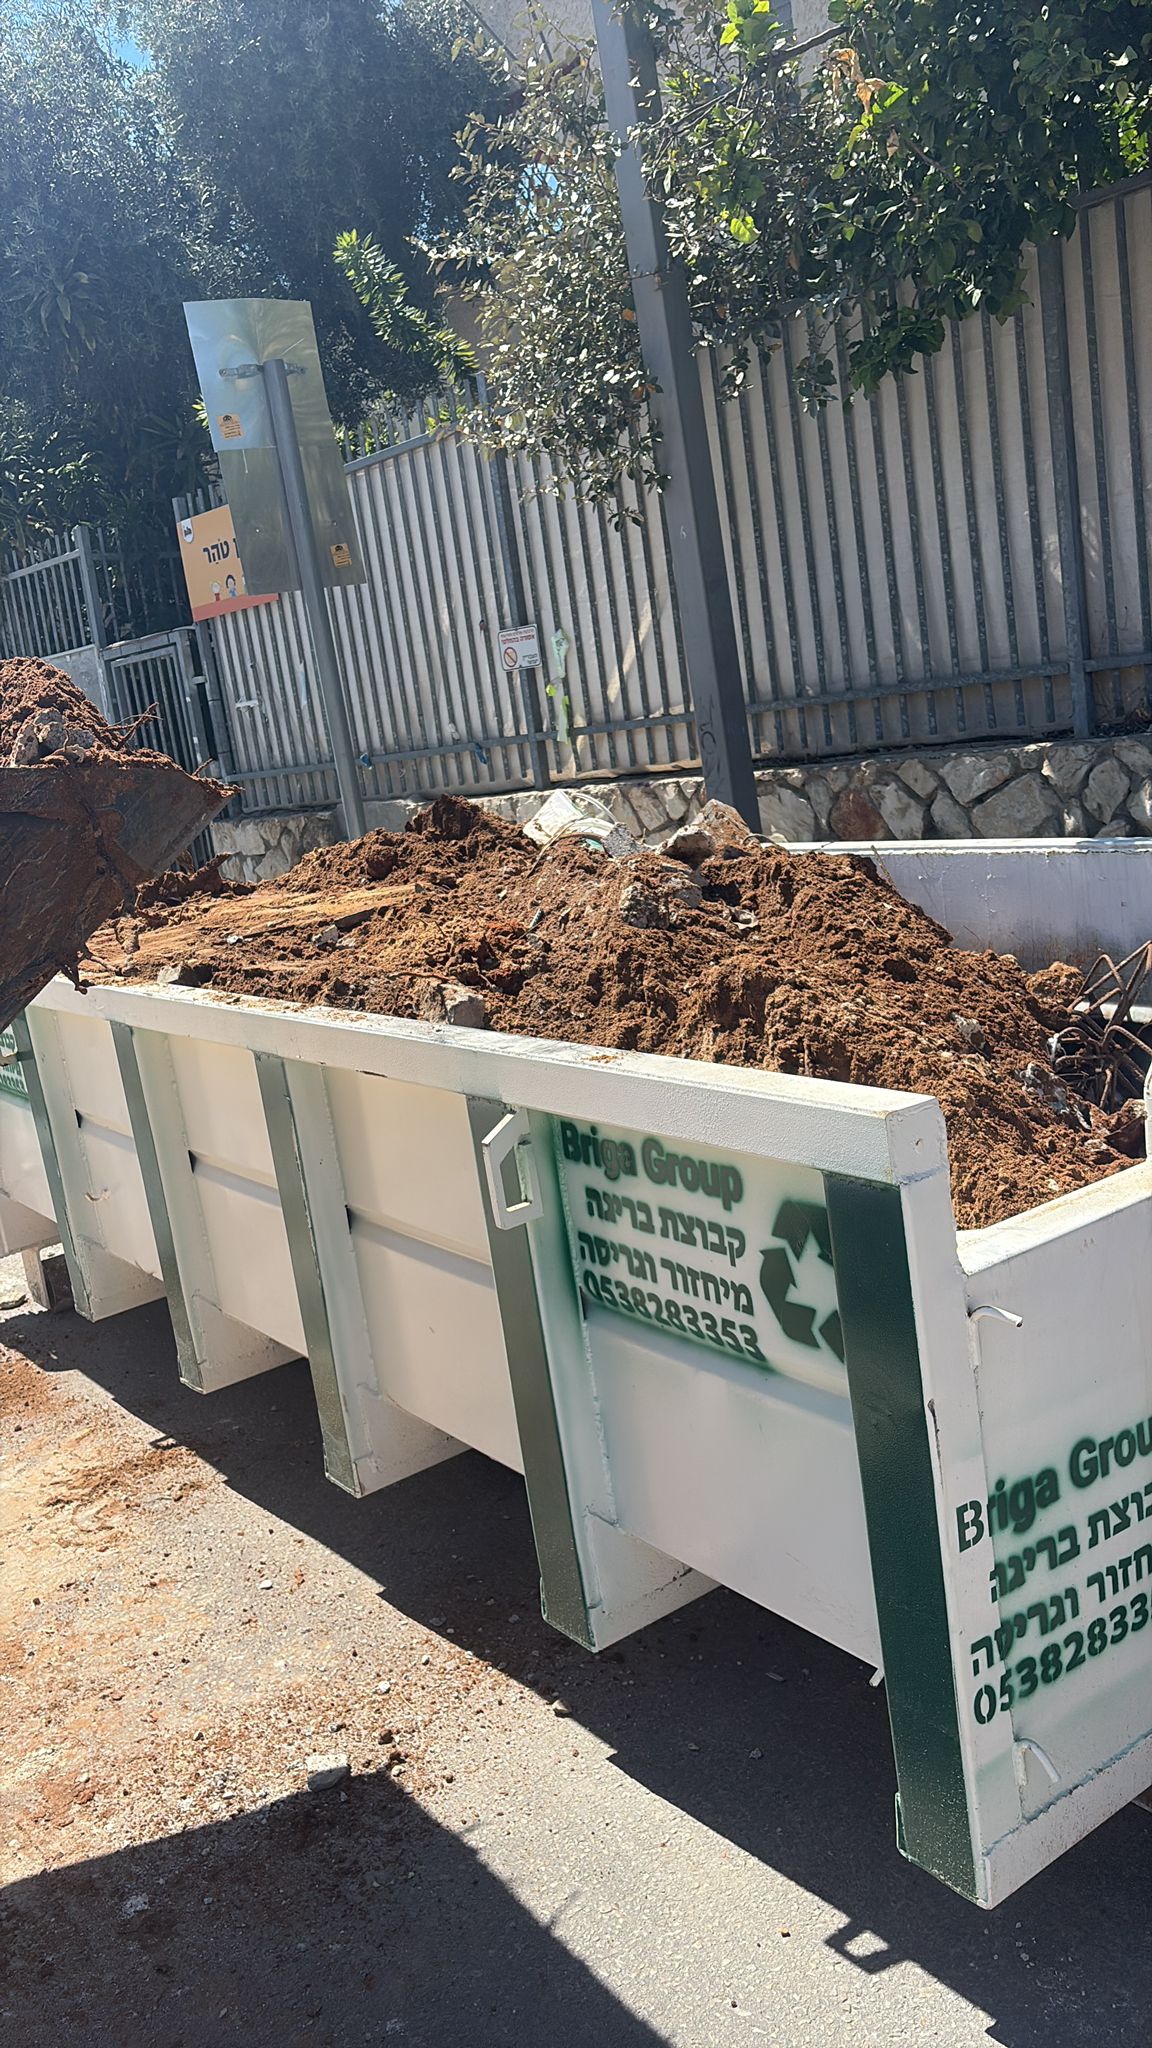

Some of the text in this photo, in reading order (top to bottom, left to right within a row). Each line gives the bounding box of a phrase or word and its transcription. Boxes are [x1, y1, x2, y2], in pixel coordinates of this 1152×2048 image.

[560, 1121, 744, 1212] Briga Group
[578, 1231, 754, 1316] מיחזור וגריסה
[658, 1206, 746, 1267] קבוצת
[583, 1269, 767, 1362] 0538283353
[956, 1416, 1152, 1553] Briga Grou
[1087, 1481, 1152, 1550] וצת
[970, 1543, 1152, 1677] חזור וגריסה
[973, 1590, 1152, 1725] 05382833
